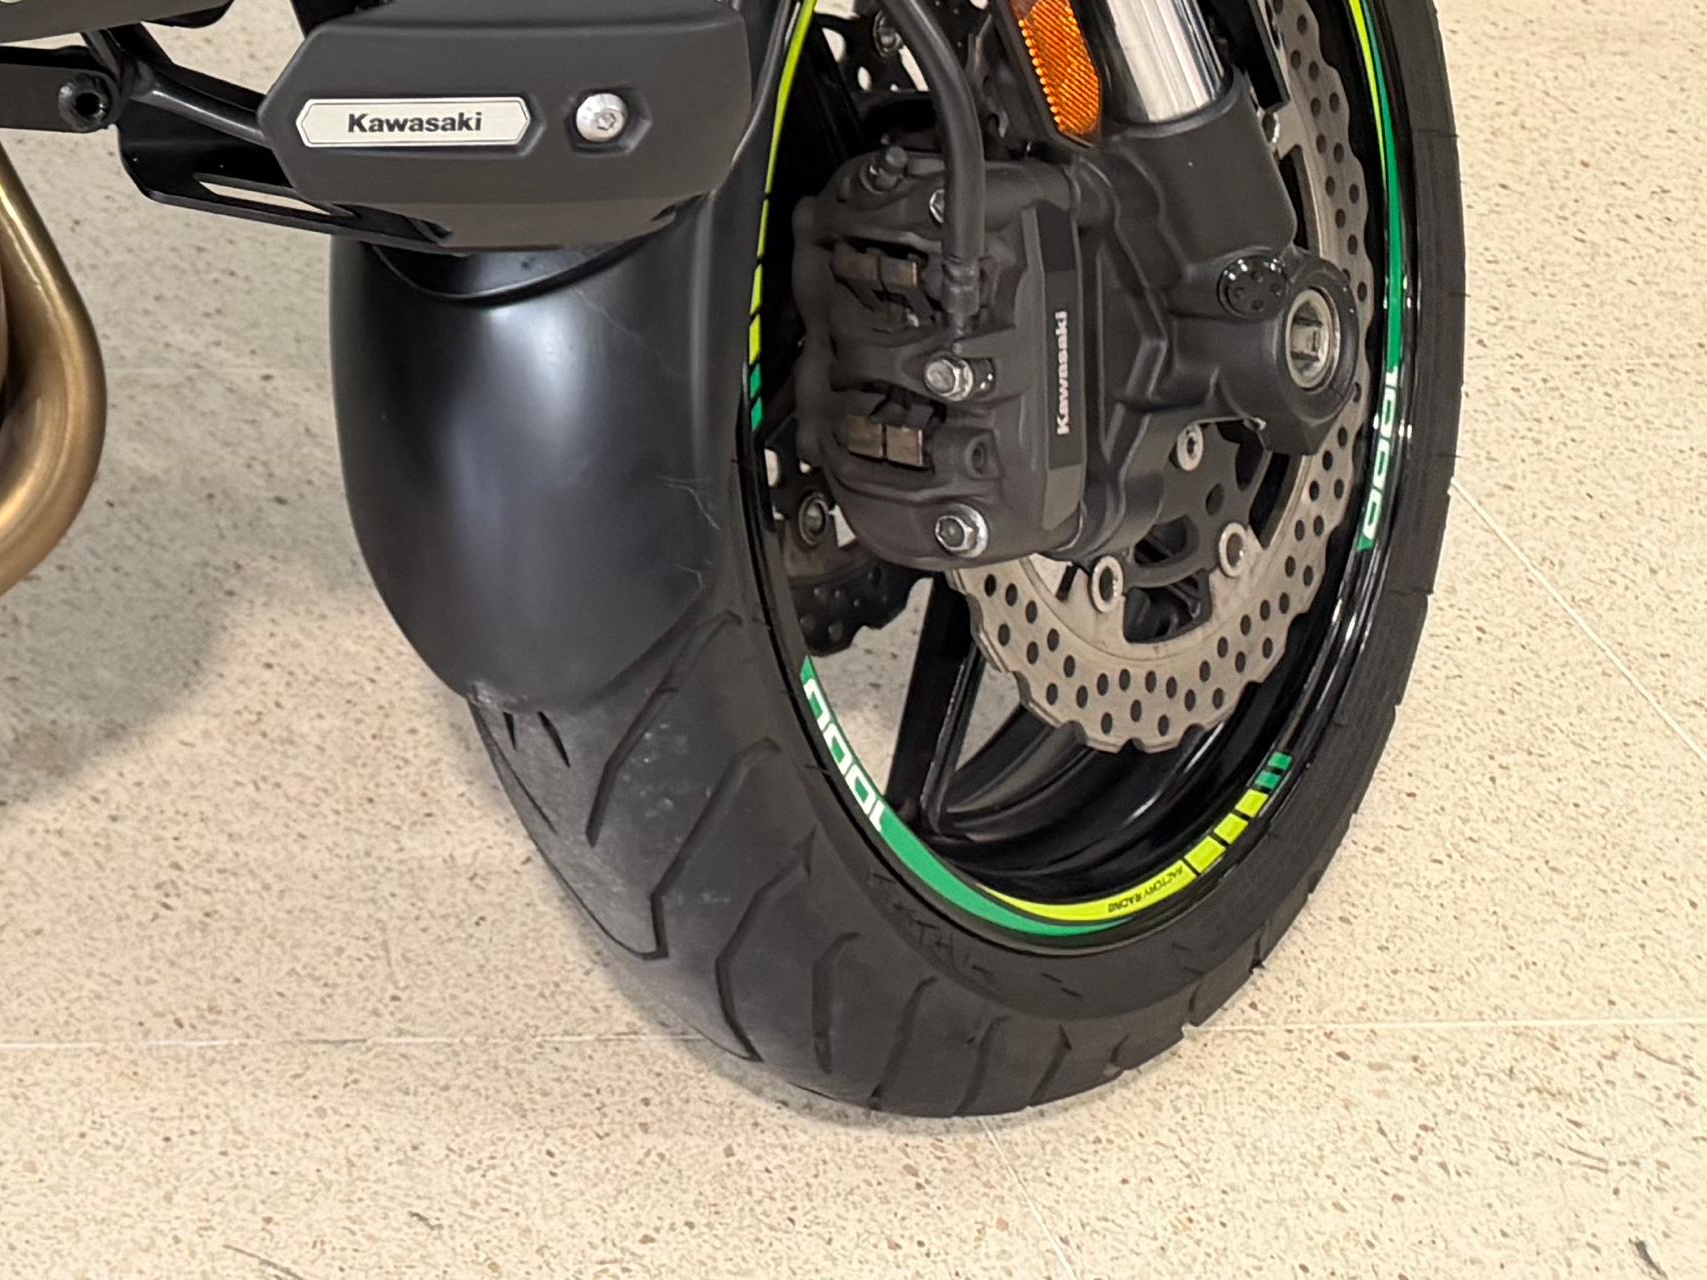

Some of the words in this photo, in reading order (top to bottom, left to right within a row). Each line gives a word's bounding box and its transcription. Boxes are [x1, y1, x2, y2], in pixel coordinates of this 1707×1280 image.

[348, 111, 483, 133] Kawasaki
[1054, 310, 1070, 436] Kawasaki
[1362, 365, 1399, 541] 1000
[803, 677, 886, 833] 1000
